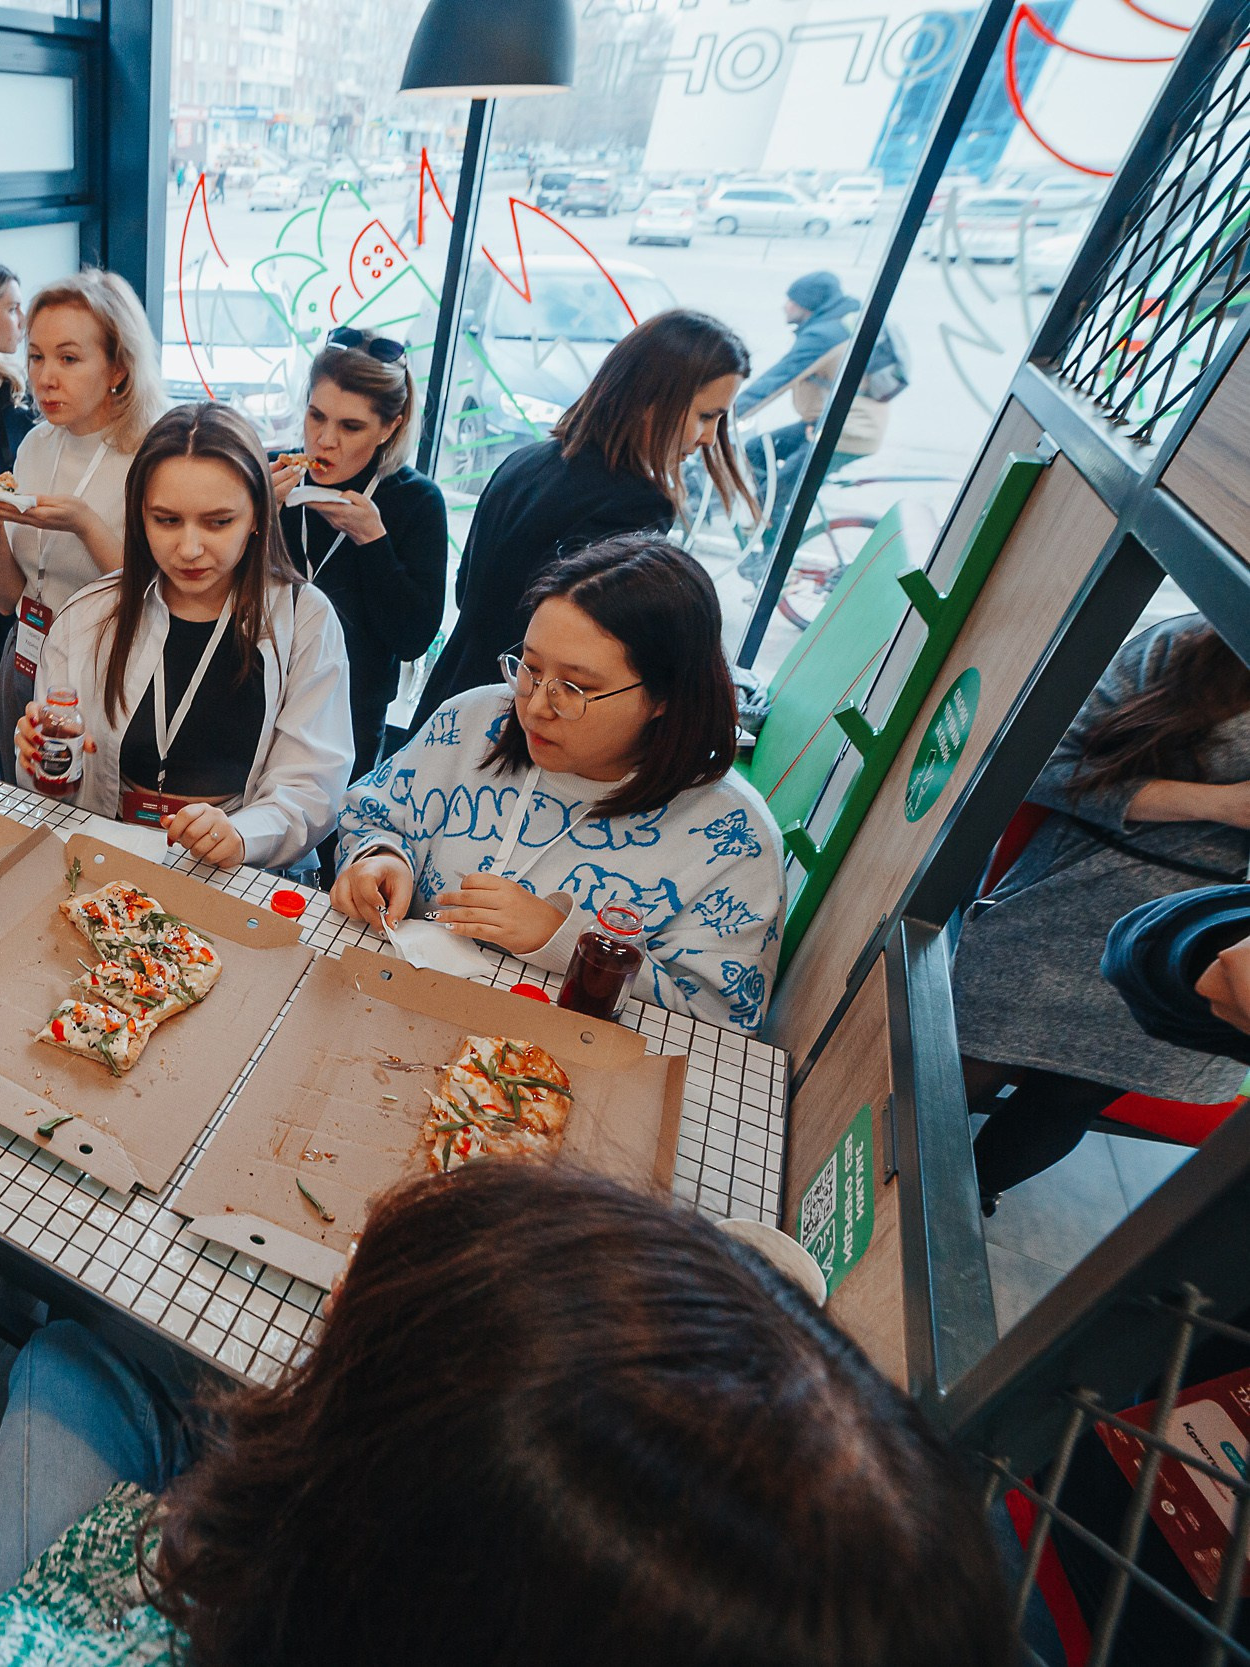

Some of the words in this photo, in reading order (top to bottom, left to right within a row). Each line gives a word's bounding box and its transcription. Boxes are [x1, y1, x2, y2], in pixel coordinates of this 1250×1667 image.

[844, 1132, 853, 1173] БЕЗ
[855, 1140, 864, 1221] ЗАКАЖИ
[843, 1175, 853, 1264] ОЧЕРЕДИ
